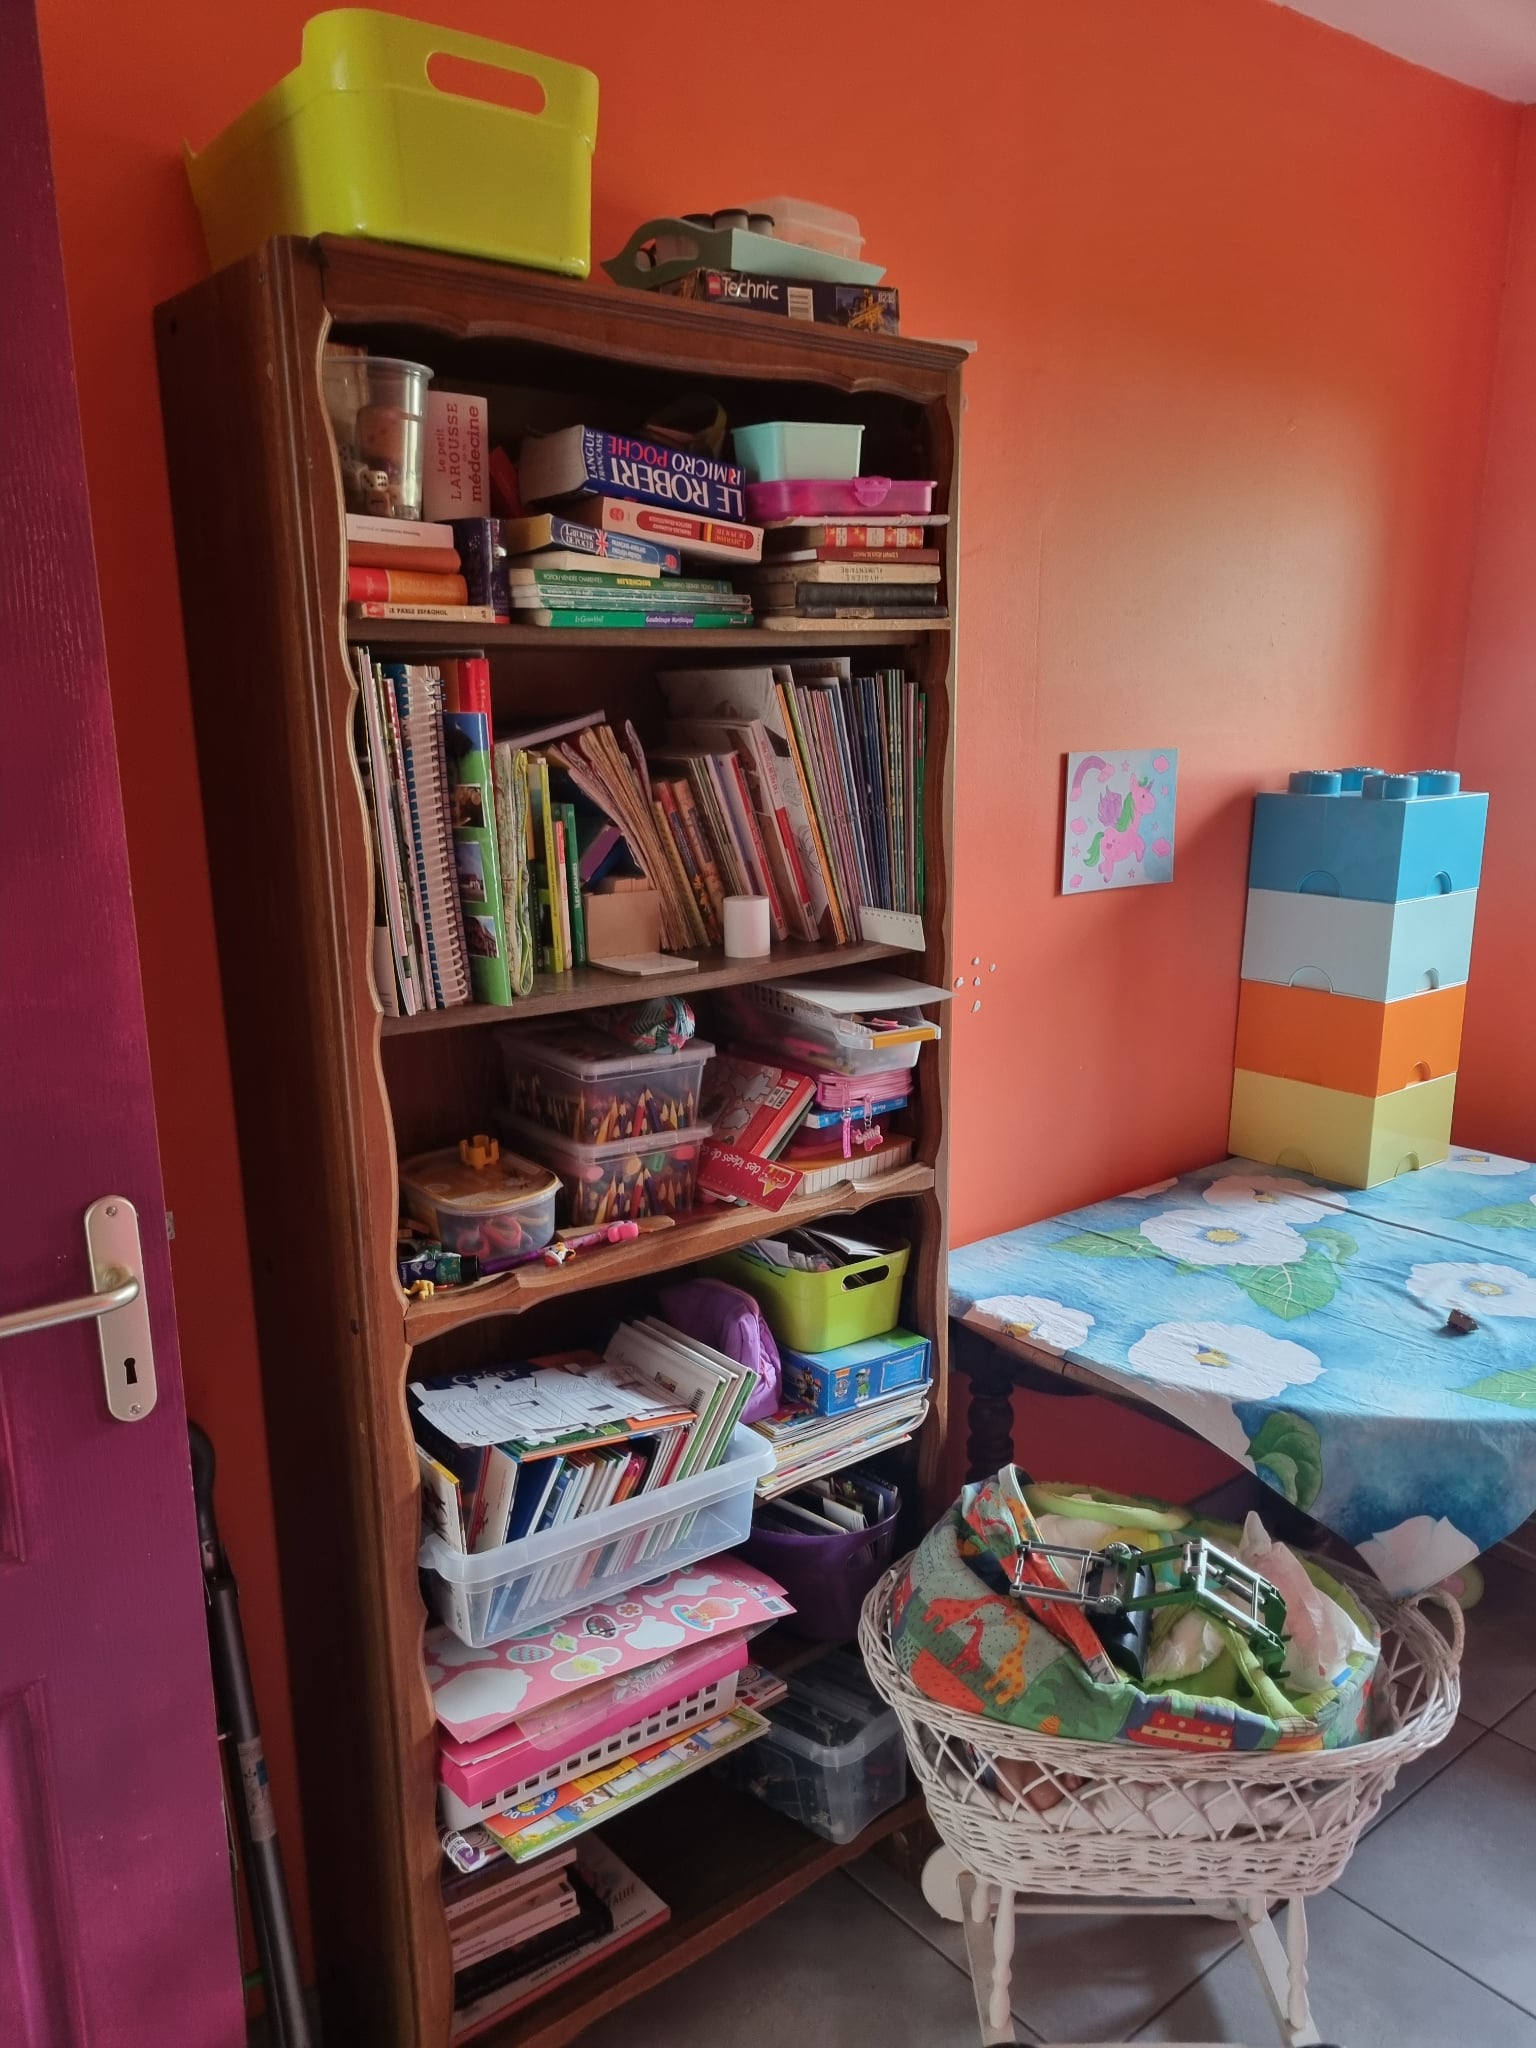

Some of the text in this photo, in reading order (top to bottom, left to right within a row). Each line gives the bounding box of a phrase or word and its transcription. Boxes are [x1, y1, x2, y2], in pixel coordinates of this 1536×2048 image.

[722, 276, 780, 301] Technic
[437, 427, 447, 473] Le petit
[447, 402, 462, 502] LAROUSSE
[465, 405, 483, 504] médecine
[585, 430, 598, 480] LANGUE
[608, 435, 669, 468] POCHE
[671, 452, 728, 482] MICRO
[610, 457, 744, 518] LE ROBERT
[417, 608, 449, 616] ESPAGNOL
[572, 862, 580, 892] CANARIES
[745, 1160, 762, 1175] des
